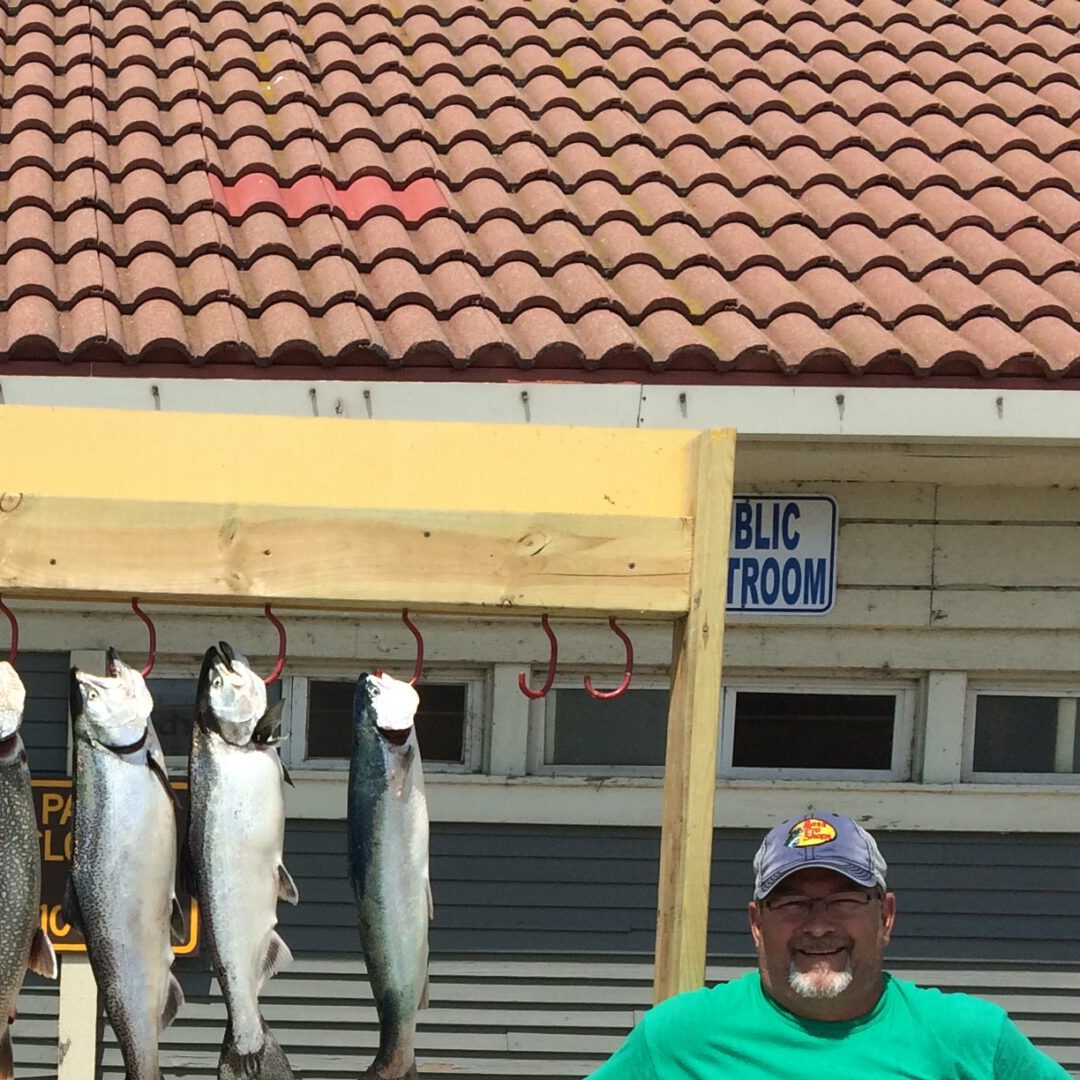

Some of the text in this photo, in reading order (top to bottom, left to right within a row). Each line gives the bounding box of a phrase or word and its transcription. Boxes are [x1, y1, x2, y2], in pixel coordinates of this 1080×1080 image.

[734, 502, 801, 551] BLIC
[727, 557, 827, 606] TROOM
[804, 818, 827, 828] Bass
